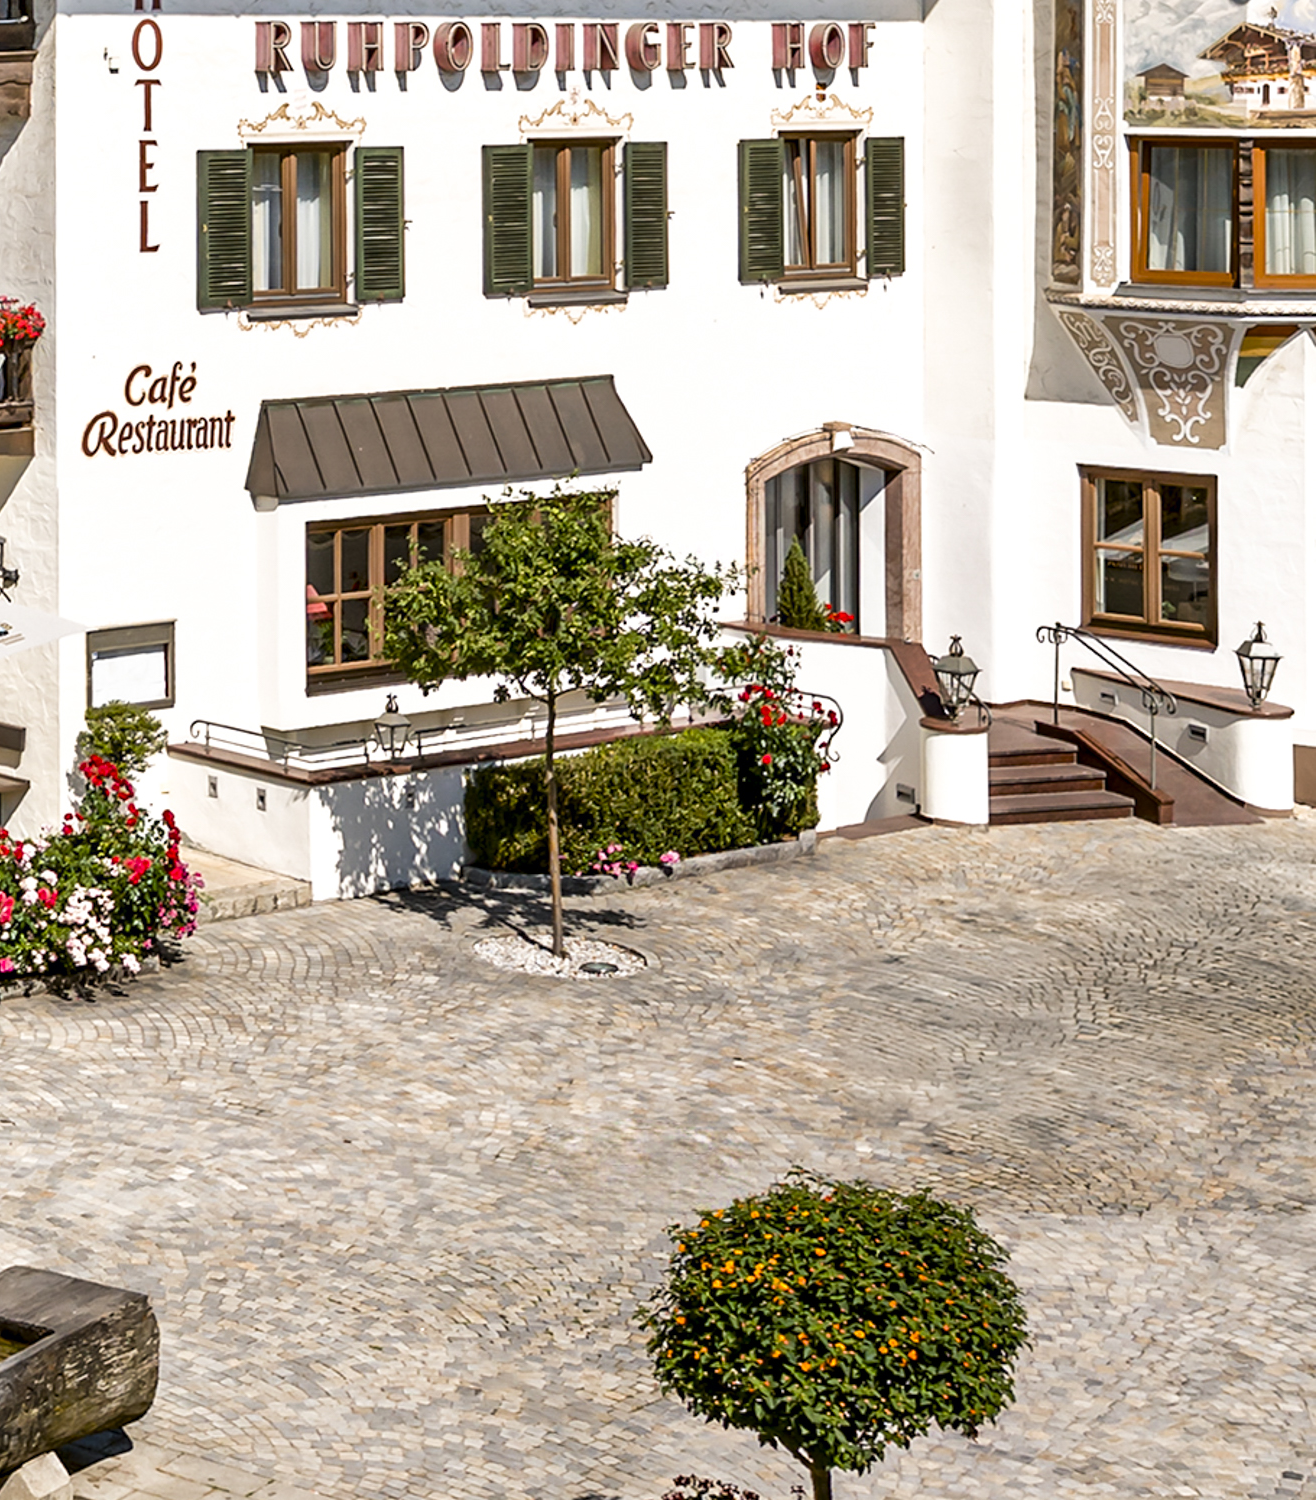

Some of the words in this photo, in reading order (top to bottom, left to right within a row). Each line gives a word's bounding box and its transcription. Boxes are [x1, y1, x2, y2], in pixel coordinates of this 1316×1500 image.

[254, 21, 735, 72] RUHPOLDINGER
[771, 22, 876, 71] HOF
[124, 360, 197, 410] Café
[81, 409, 235, 457] Restaurant
